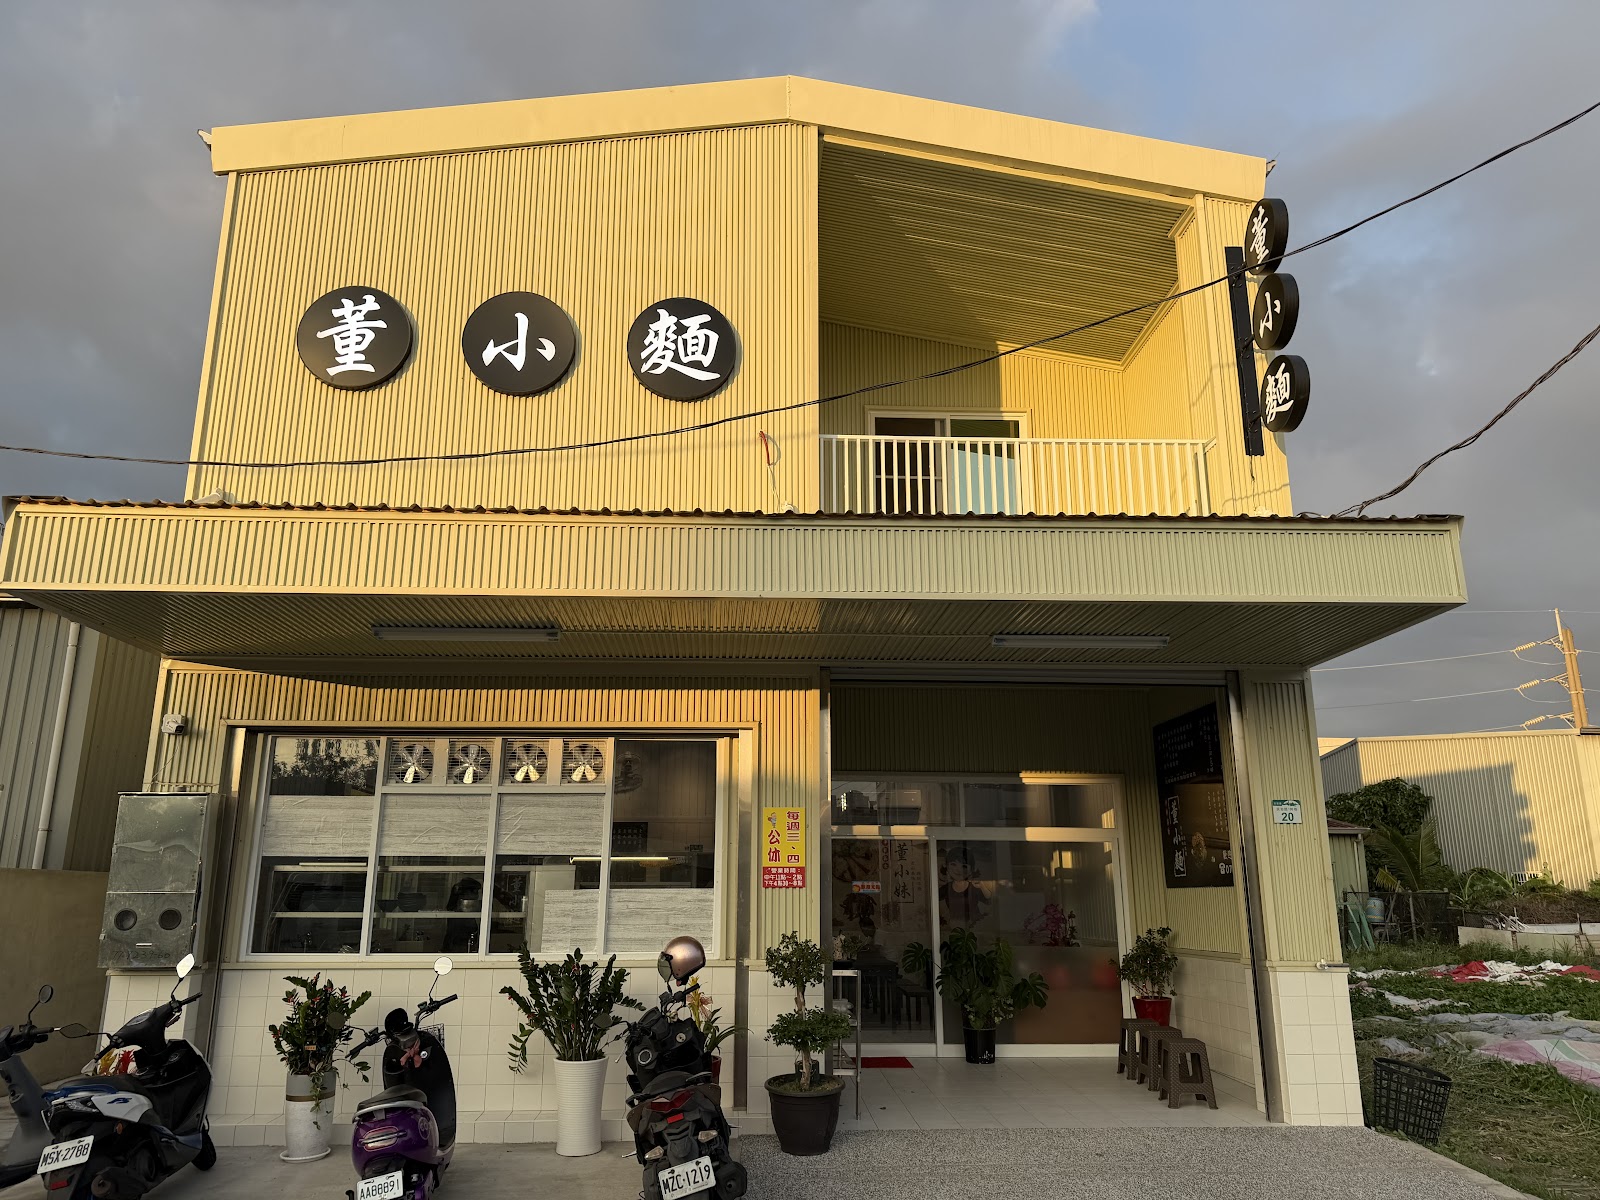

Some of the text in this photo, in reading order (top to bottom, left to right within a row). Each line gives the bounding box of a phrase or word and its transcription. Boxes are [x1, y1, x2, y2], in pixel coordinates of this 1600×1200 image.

[316, 294, 721, 381] 董小麵
[1250, 205, 1294, 424] 董小麵
[786, 811, 800, 863] 每週三、四
[1281, 812, 1294, 822] 20
[767, 829, 781, 863] 公休
[894, 842, 911, 899] 董小妹
[40, 1142, 90, 1167] MSX-2788
